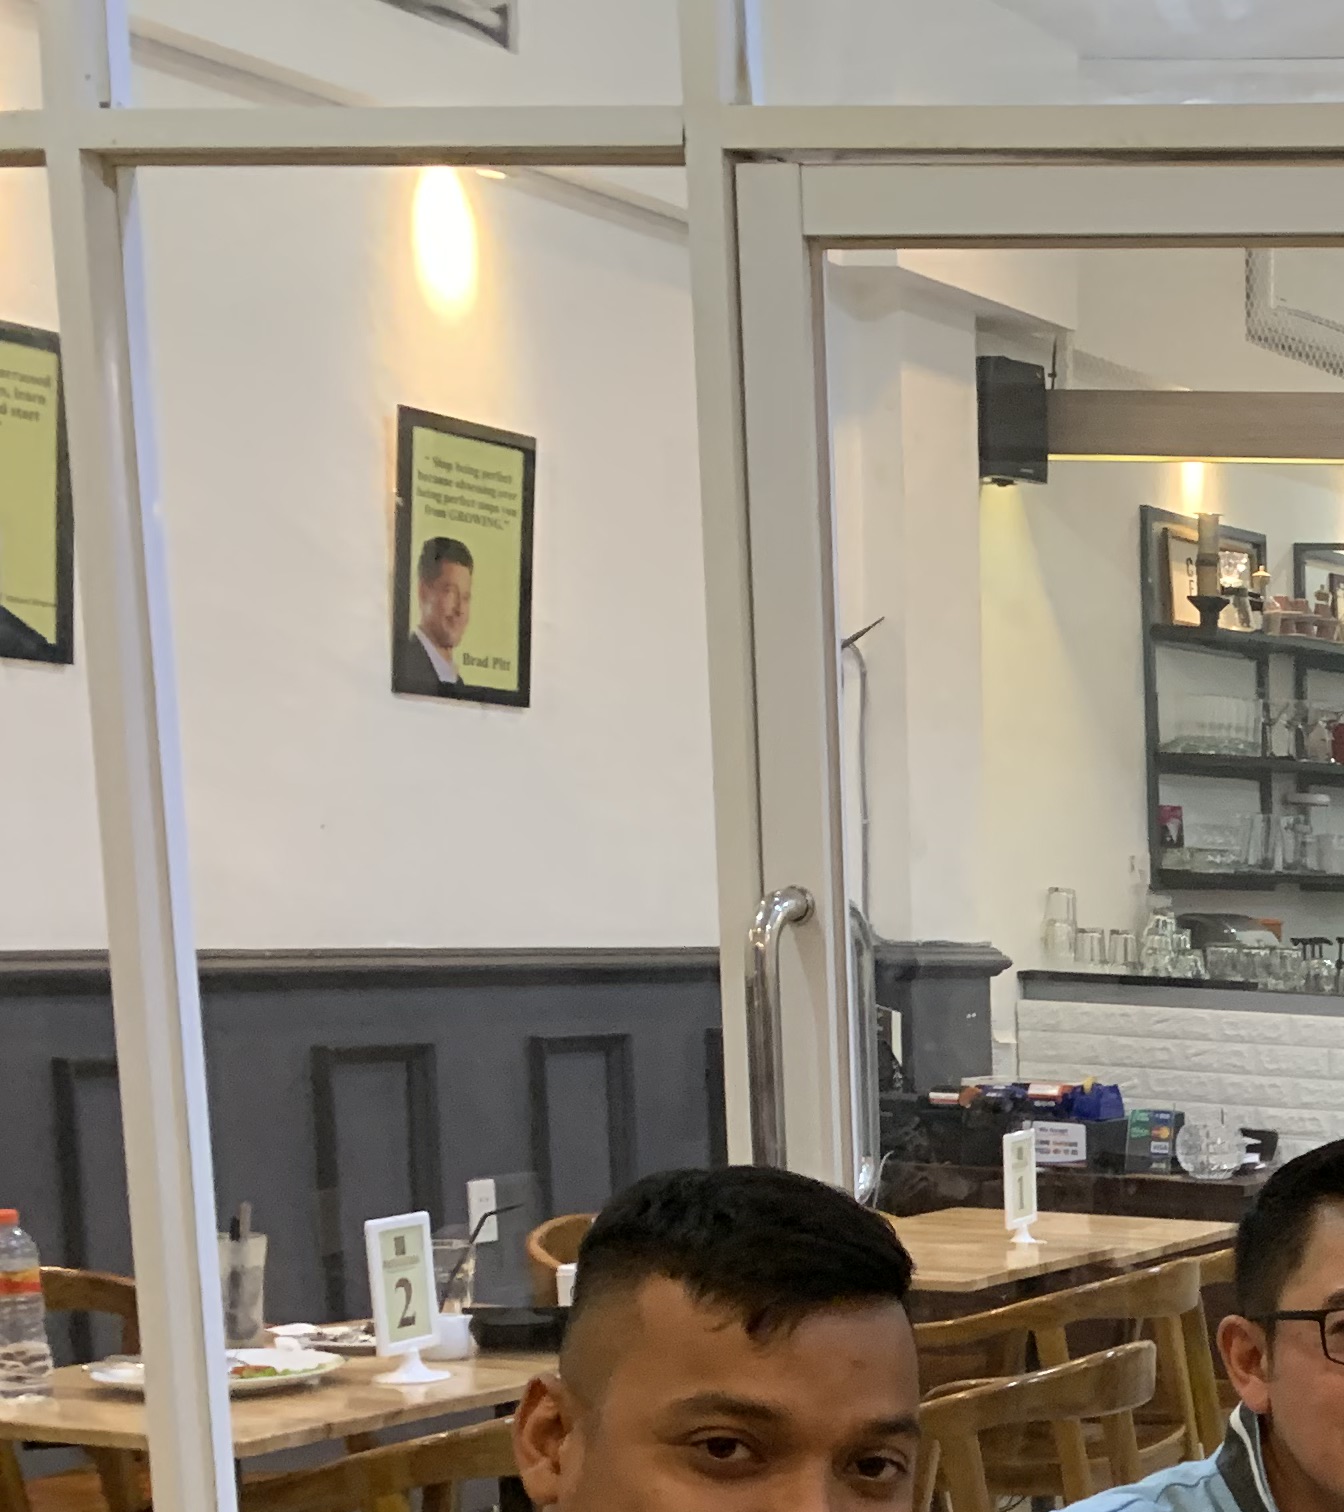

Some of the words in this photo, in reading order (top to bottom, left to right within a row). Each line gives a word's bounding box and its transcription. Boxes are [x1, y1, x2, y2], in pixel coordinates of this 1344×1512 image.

[462, 652, 489, 669] Brad
[492, 656, 511, 672] Pitt
[1152, 1142, 1169, 1150] VISA
[1018, 1175, 1025, 1210] 1
[395, 1277, 416, 1329] 2
